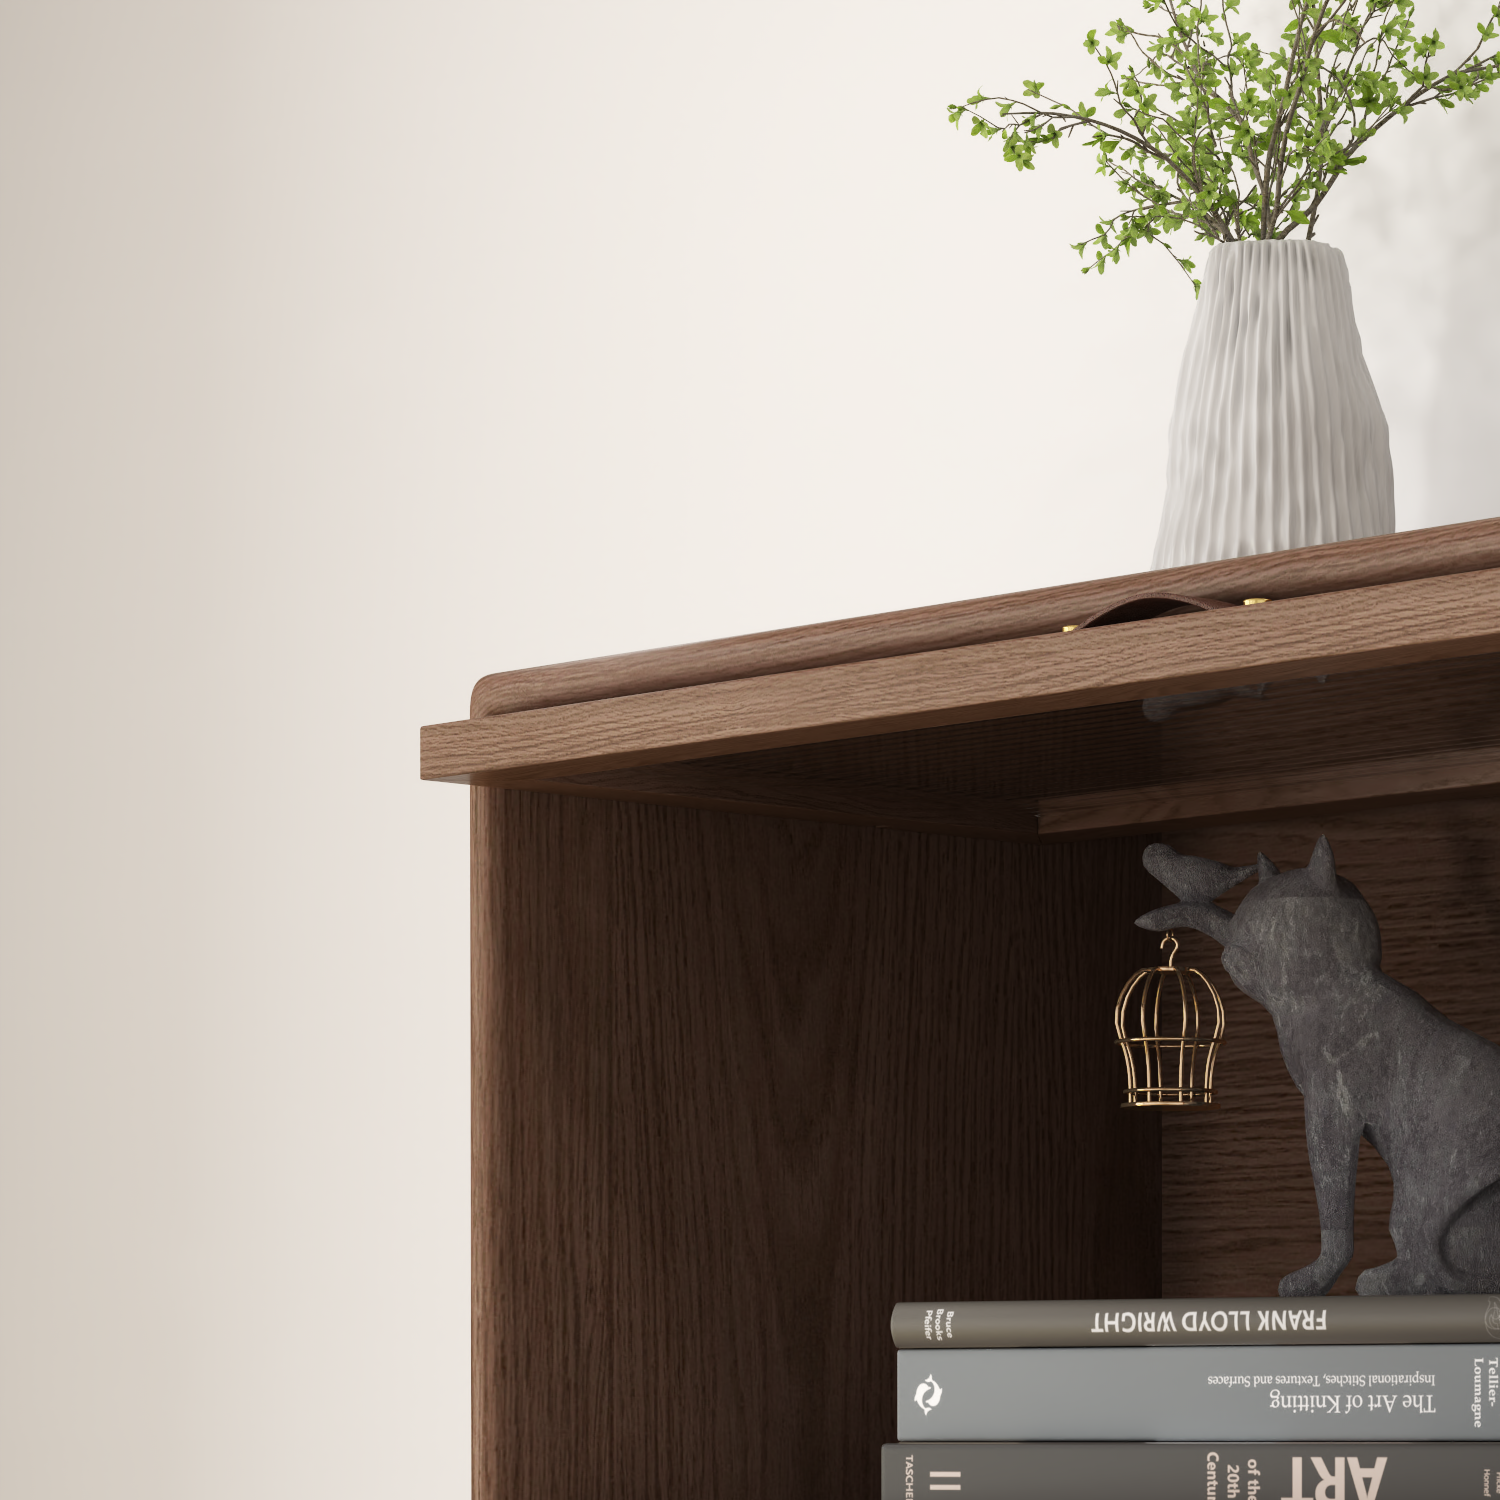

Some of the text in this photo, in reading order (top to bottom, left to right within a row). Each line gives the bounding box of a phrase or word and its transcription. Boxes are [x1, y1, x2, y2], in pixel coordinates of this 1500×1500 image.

[923, 1309, 934, 1341] Pfeifer
[934, 1308, 945, 1341] Brooks
[945, 1310, 955, 1339] Bruce
[1090, 1309, 1327, 1333] FRANK LLOYD WRIGHT
[1207, 1370, 1436, 1388] Inspirational Stitches, Textures and Surfaces
[1471, 1357, 1485, 1428] Loumagne
[1488, 1357, 1499, 1407] Tellier-
[1269, 1388, 1437, 1415] The Art of Knitting
[1226, 1464, 1241, 1499] 20th
[1247, 1459, 1261, 1476] of
[1483, 1468, 1492, 1497] Honnef
